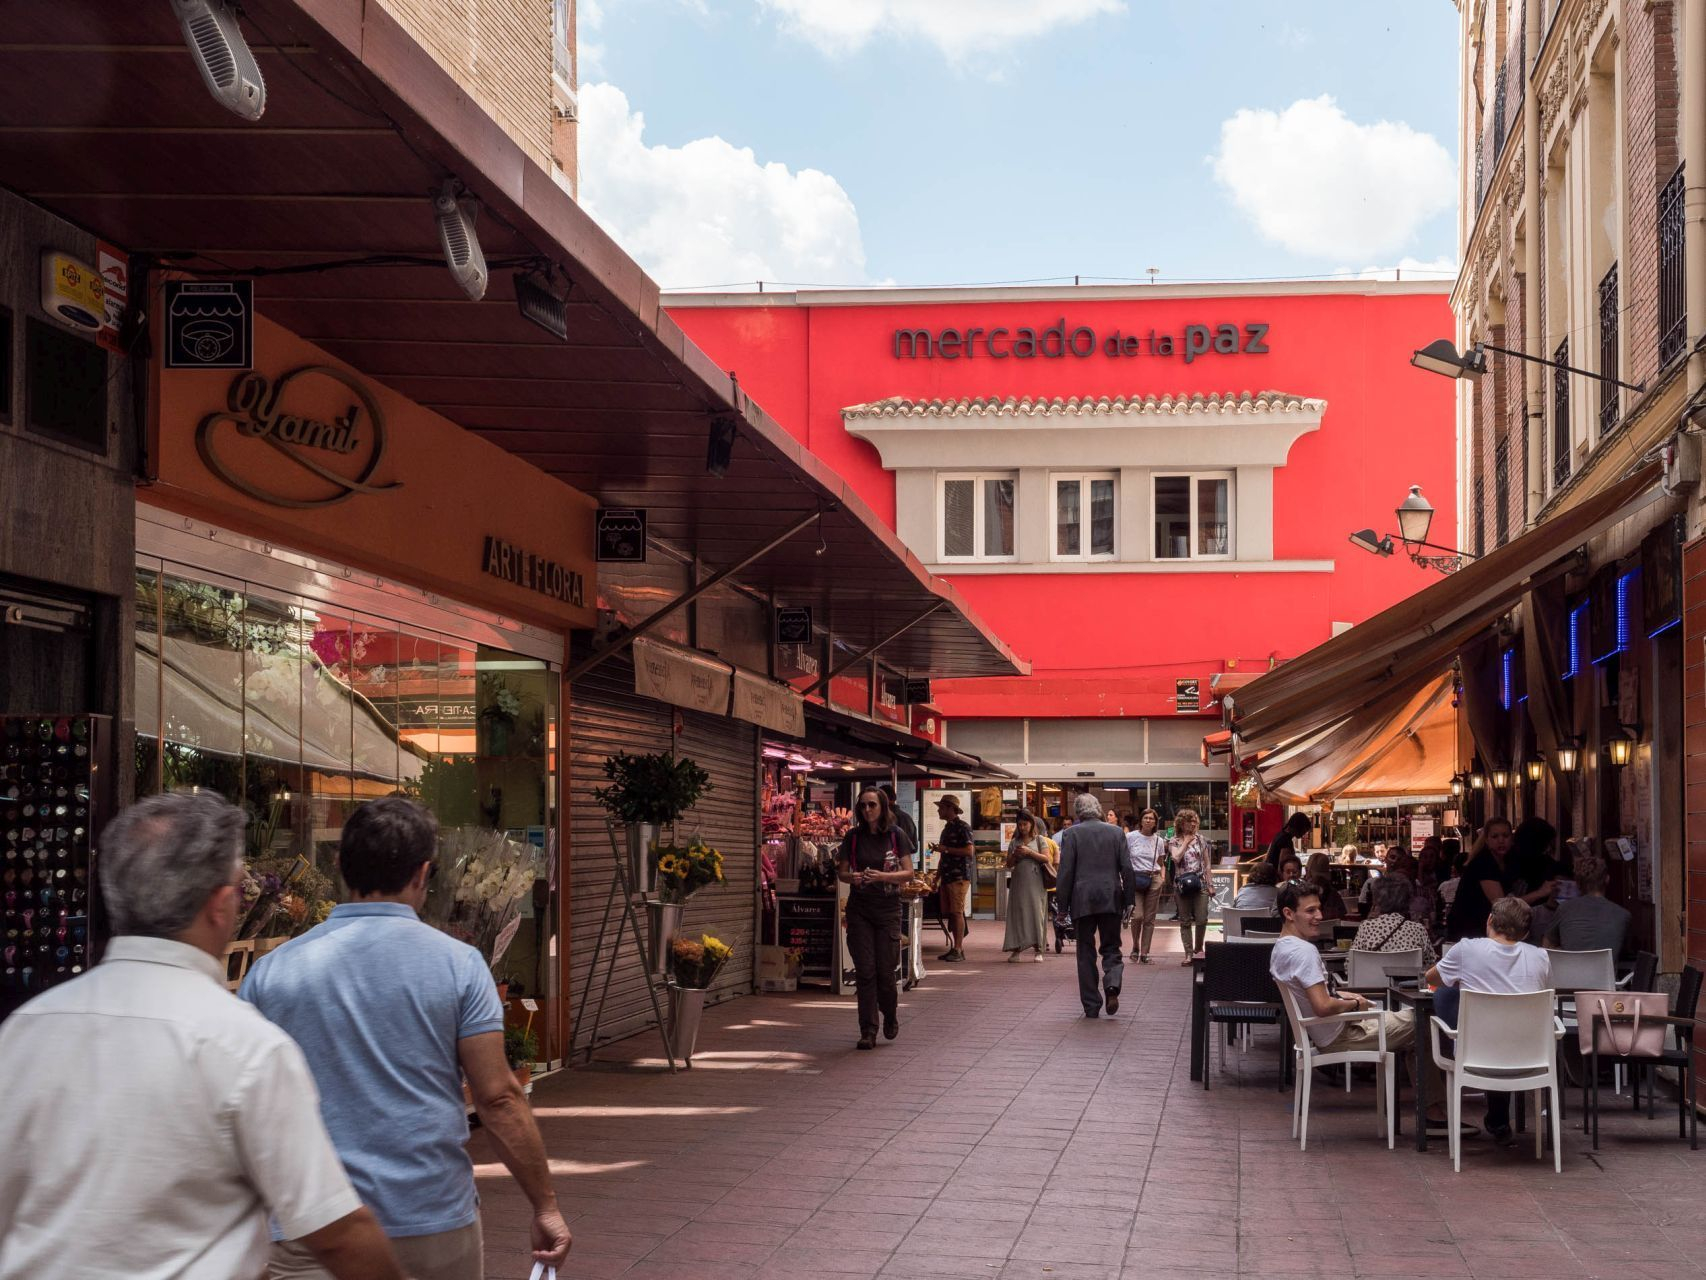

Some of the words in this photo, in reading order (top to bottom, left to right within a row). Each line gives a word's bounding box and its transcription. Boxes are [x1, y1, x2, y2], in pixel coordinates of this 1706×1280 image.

[894, 318, 1096, 359] mercado
[1104, 329, 1139, 357] de
[1151, 328, 1175, 356] la
[1184, 322, 1270, 363] paz
[482, 535, 532, 590] ARTE
